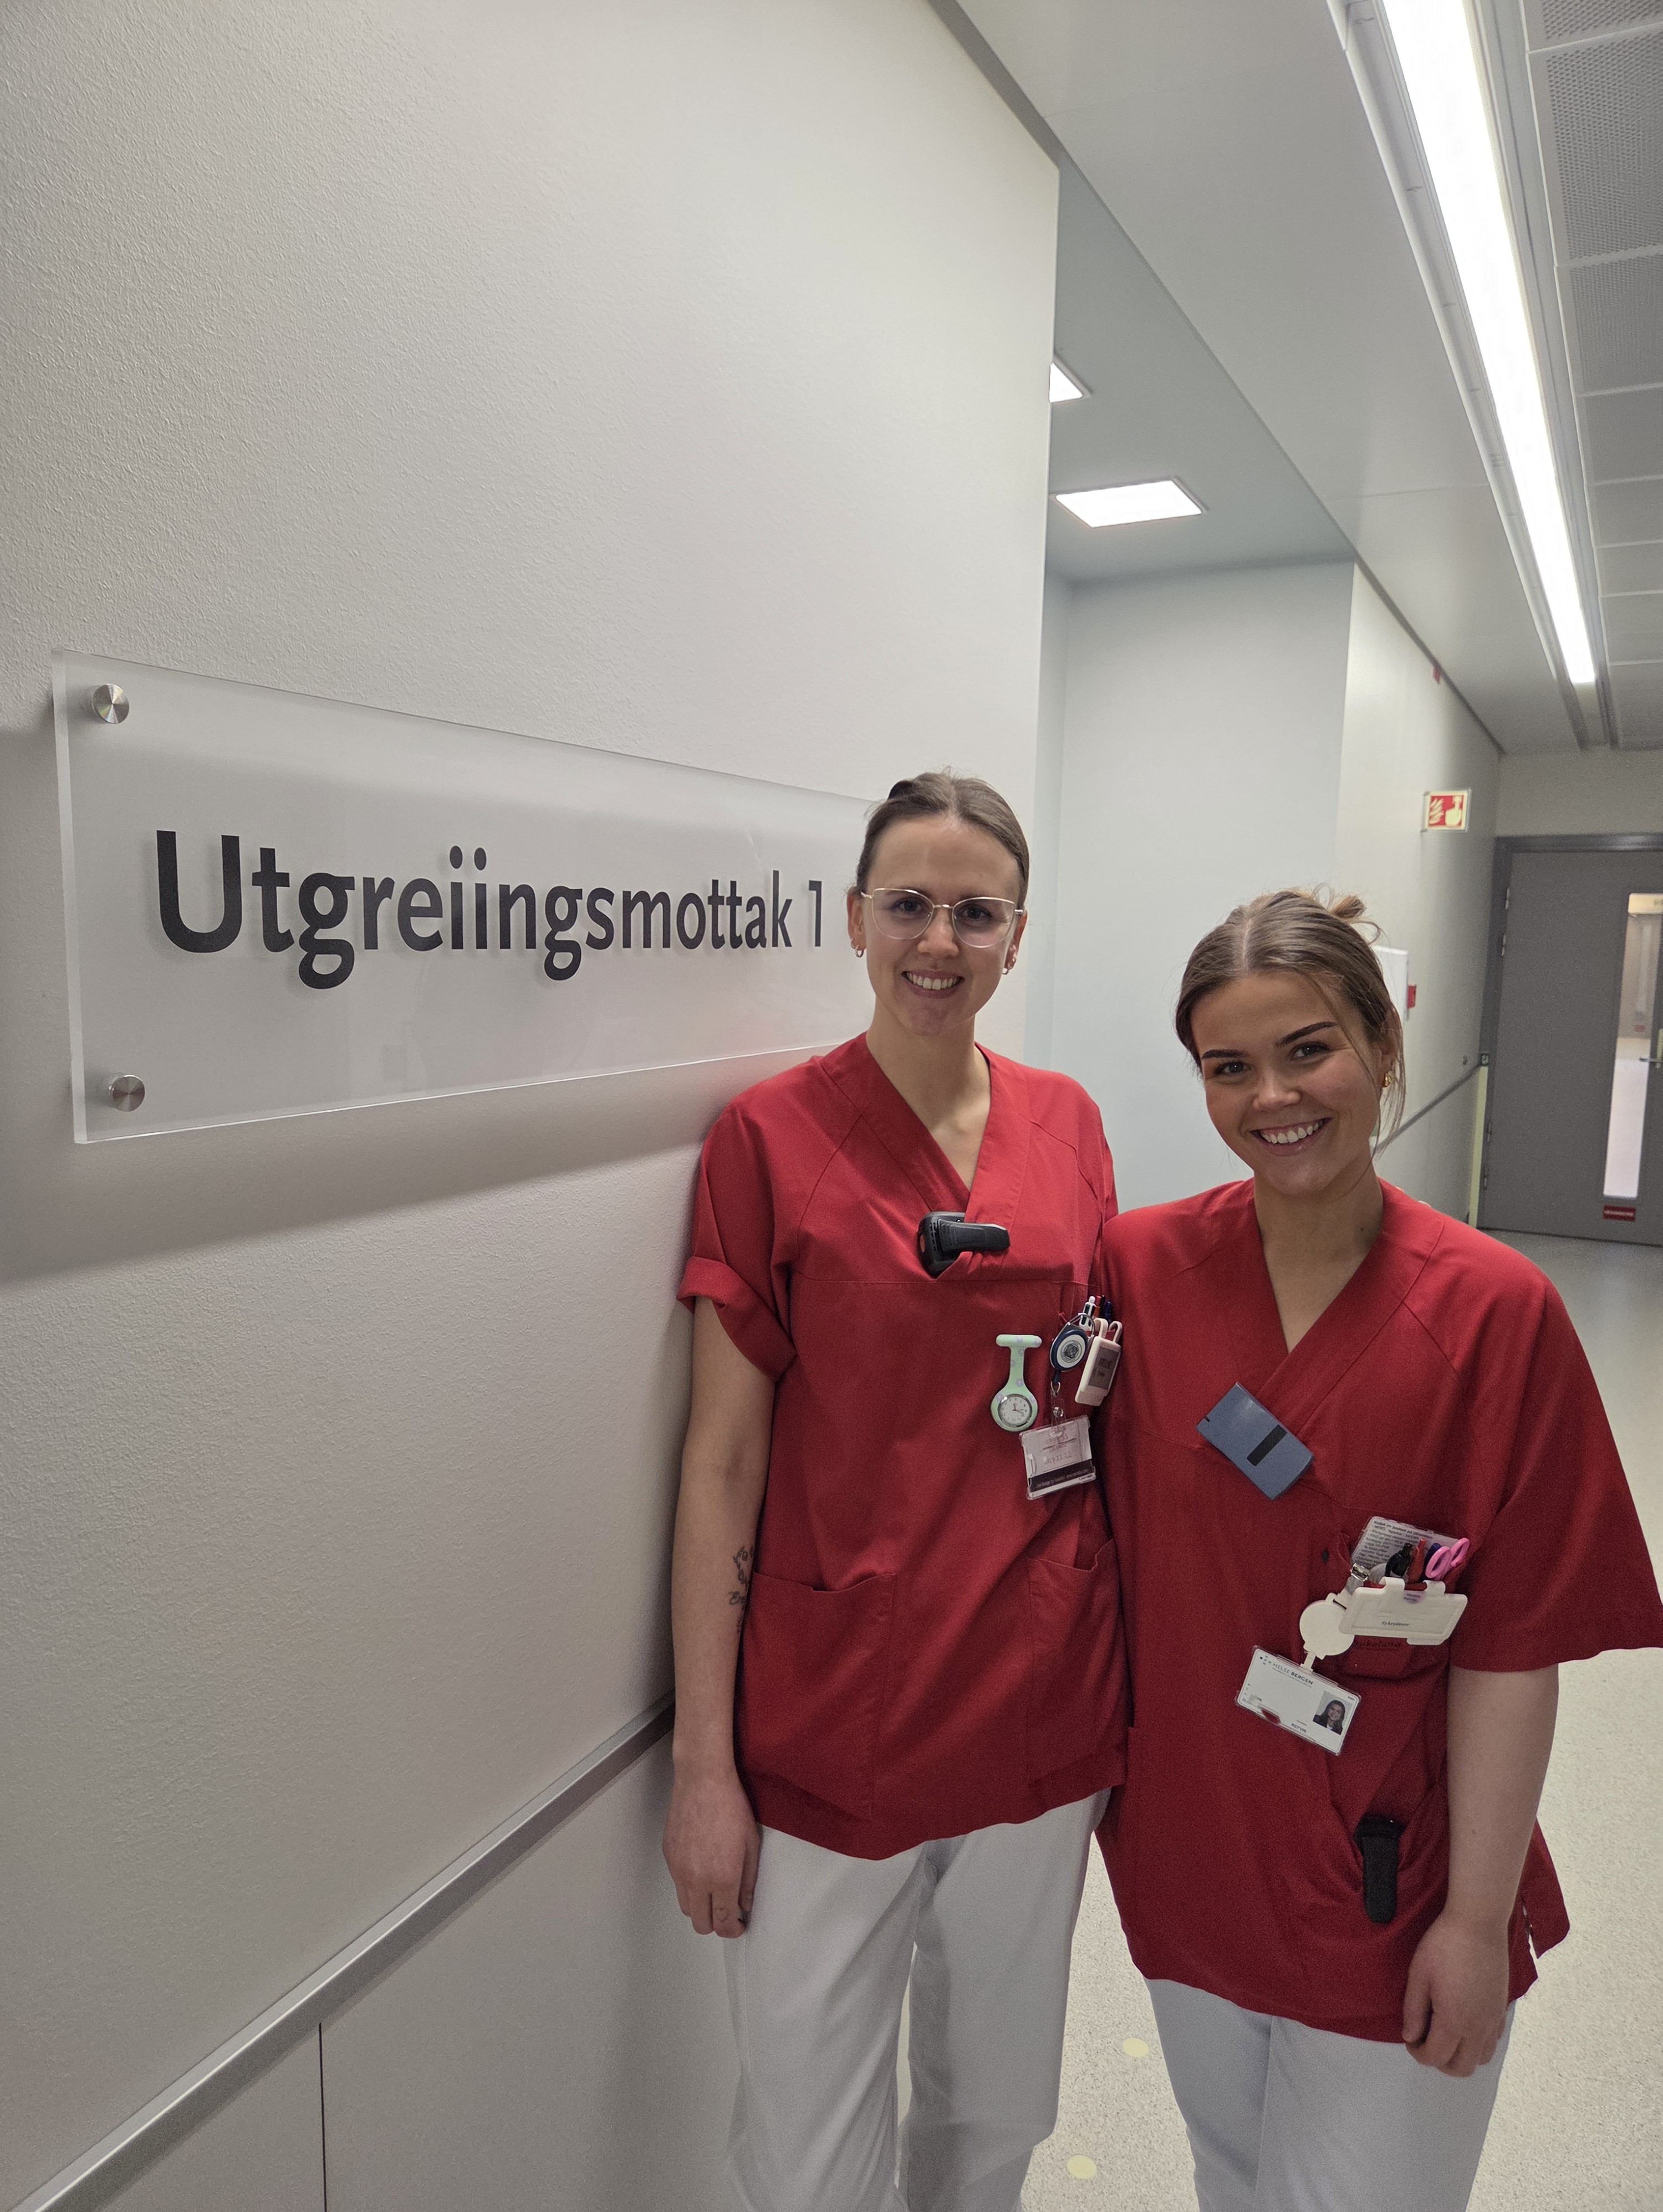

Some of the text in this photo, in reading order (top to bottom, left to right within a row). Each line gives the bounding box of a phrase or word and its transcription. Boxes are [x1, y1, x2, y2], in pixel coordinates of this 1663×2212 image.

[157, 830, 822, 990] Utgreiingsmottak 1
[1273, 1663, 1290, 1674] HELSE
[1290, 1672, 1313, 1685] BERGEN
